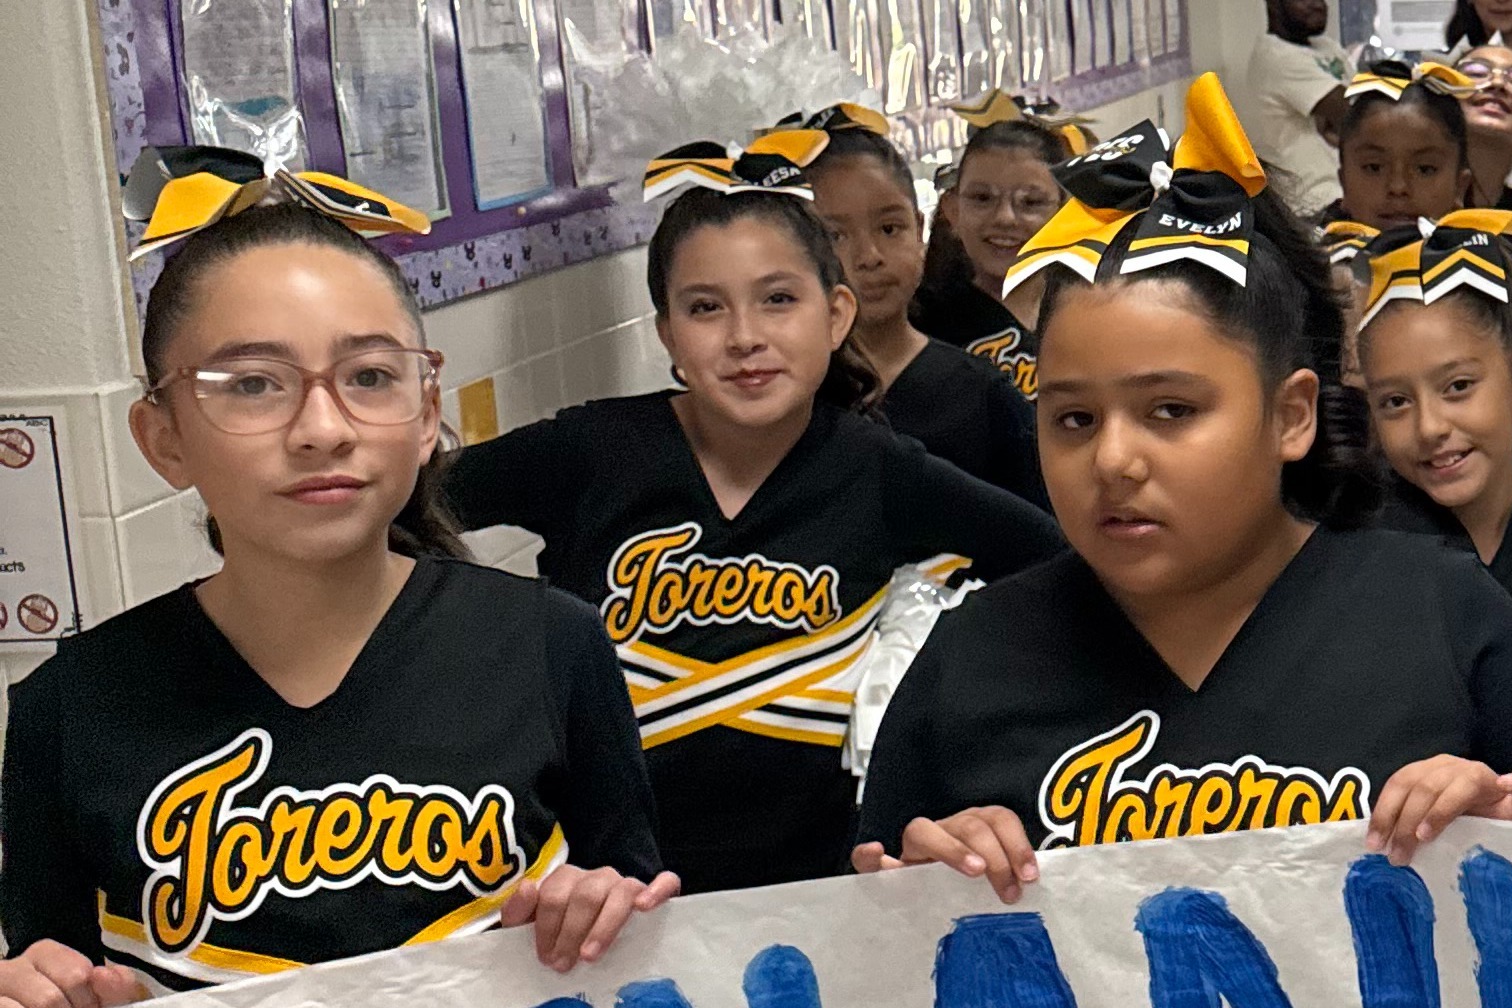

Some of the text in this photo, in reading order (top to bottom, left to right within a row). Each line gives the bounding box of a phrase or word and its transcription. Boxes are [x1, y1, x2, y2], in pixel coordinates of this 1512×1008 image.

[1158, 211, 1243, 235] EVELYN
[600, 521, 842, 650] Toreros
[137, 727, 526, 958] Toreros
